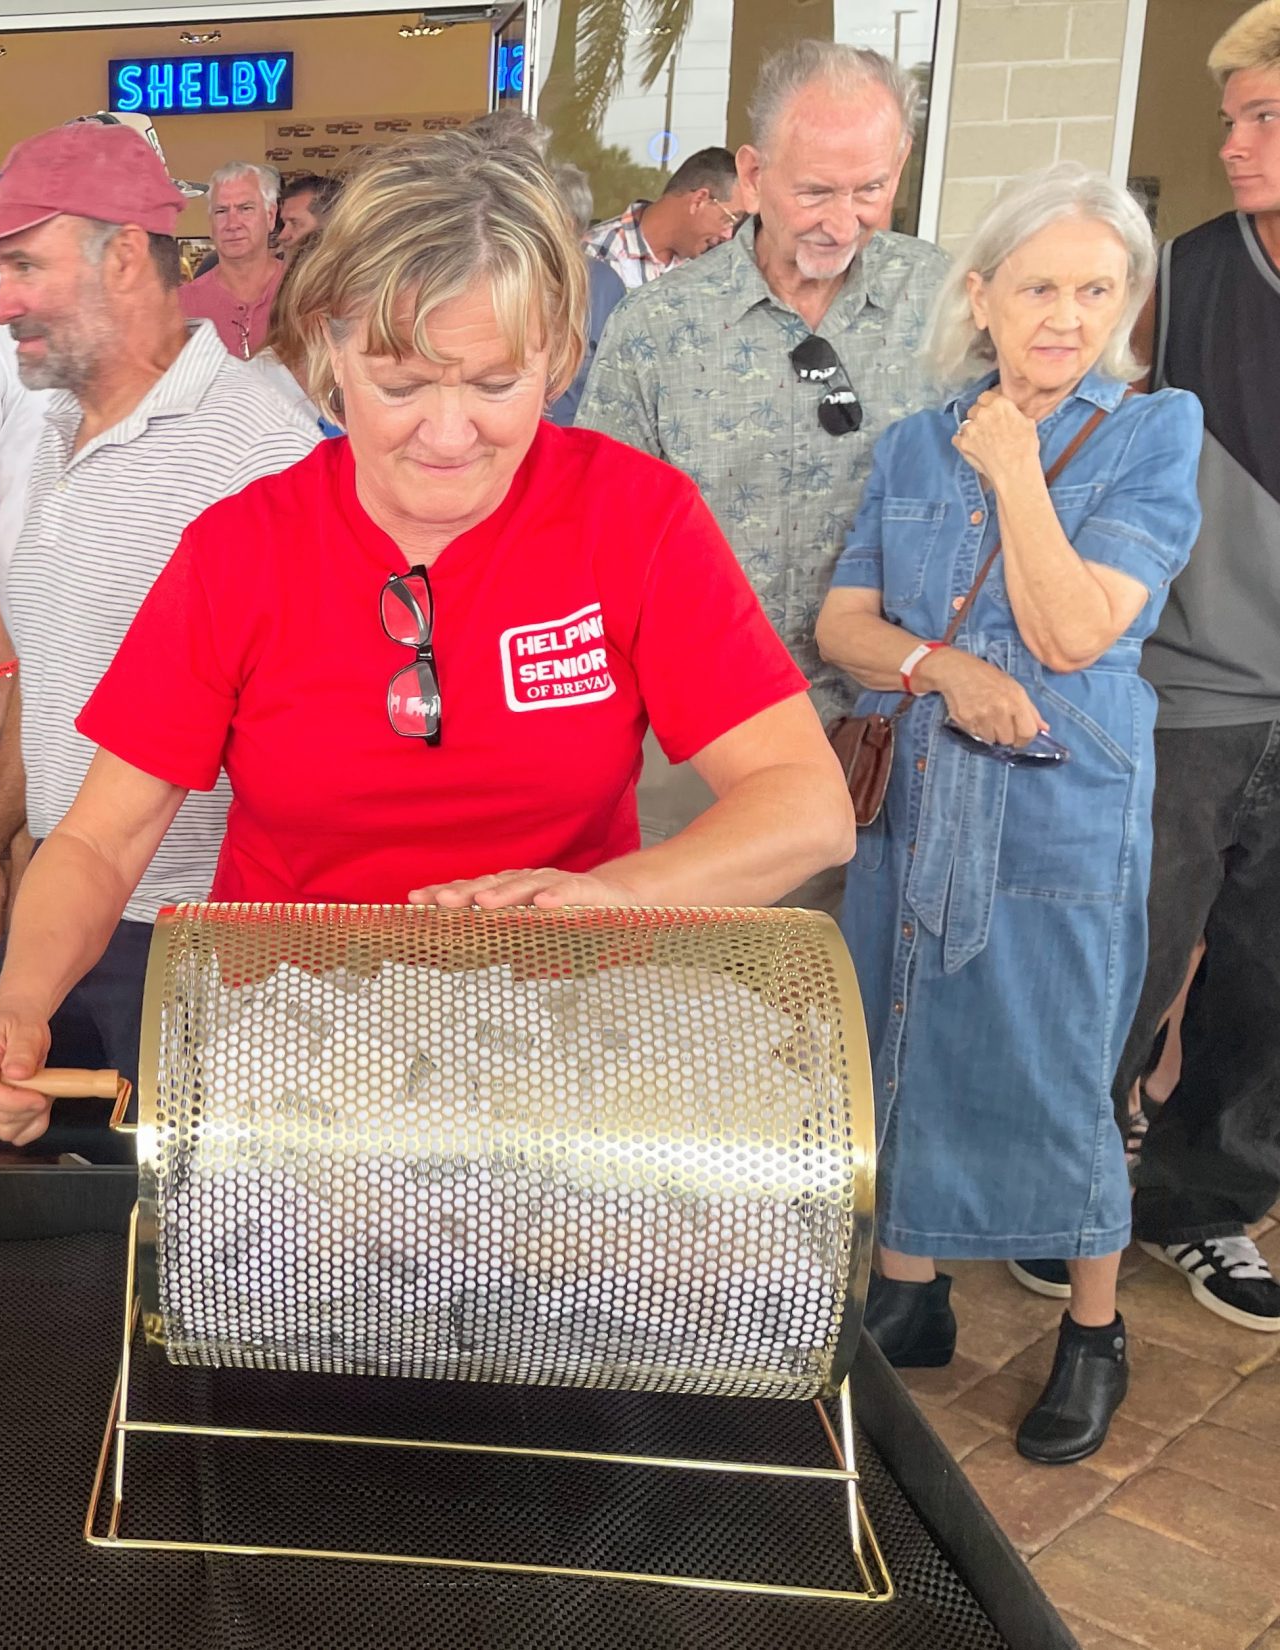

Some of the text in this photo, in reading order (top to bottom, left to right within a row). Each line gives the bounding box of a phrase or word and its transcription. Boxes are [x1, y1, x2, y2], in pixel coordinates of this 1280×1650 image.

[117, 58, 287, 111] SHELBY
[519, 648, 608, 683] SENIOR
[527, 673, 610, 699] OF BREVA
